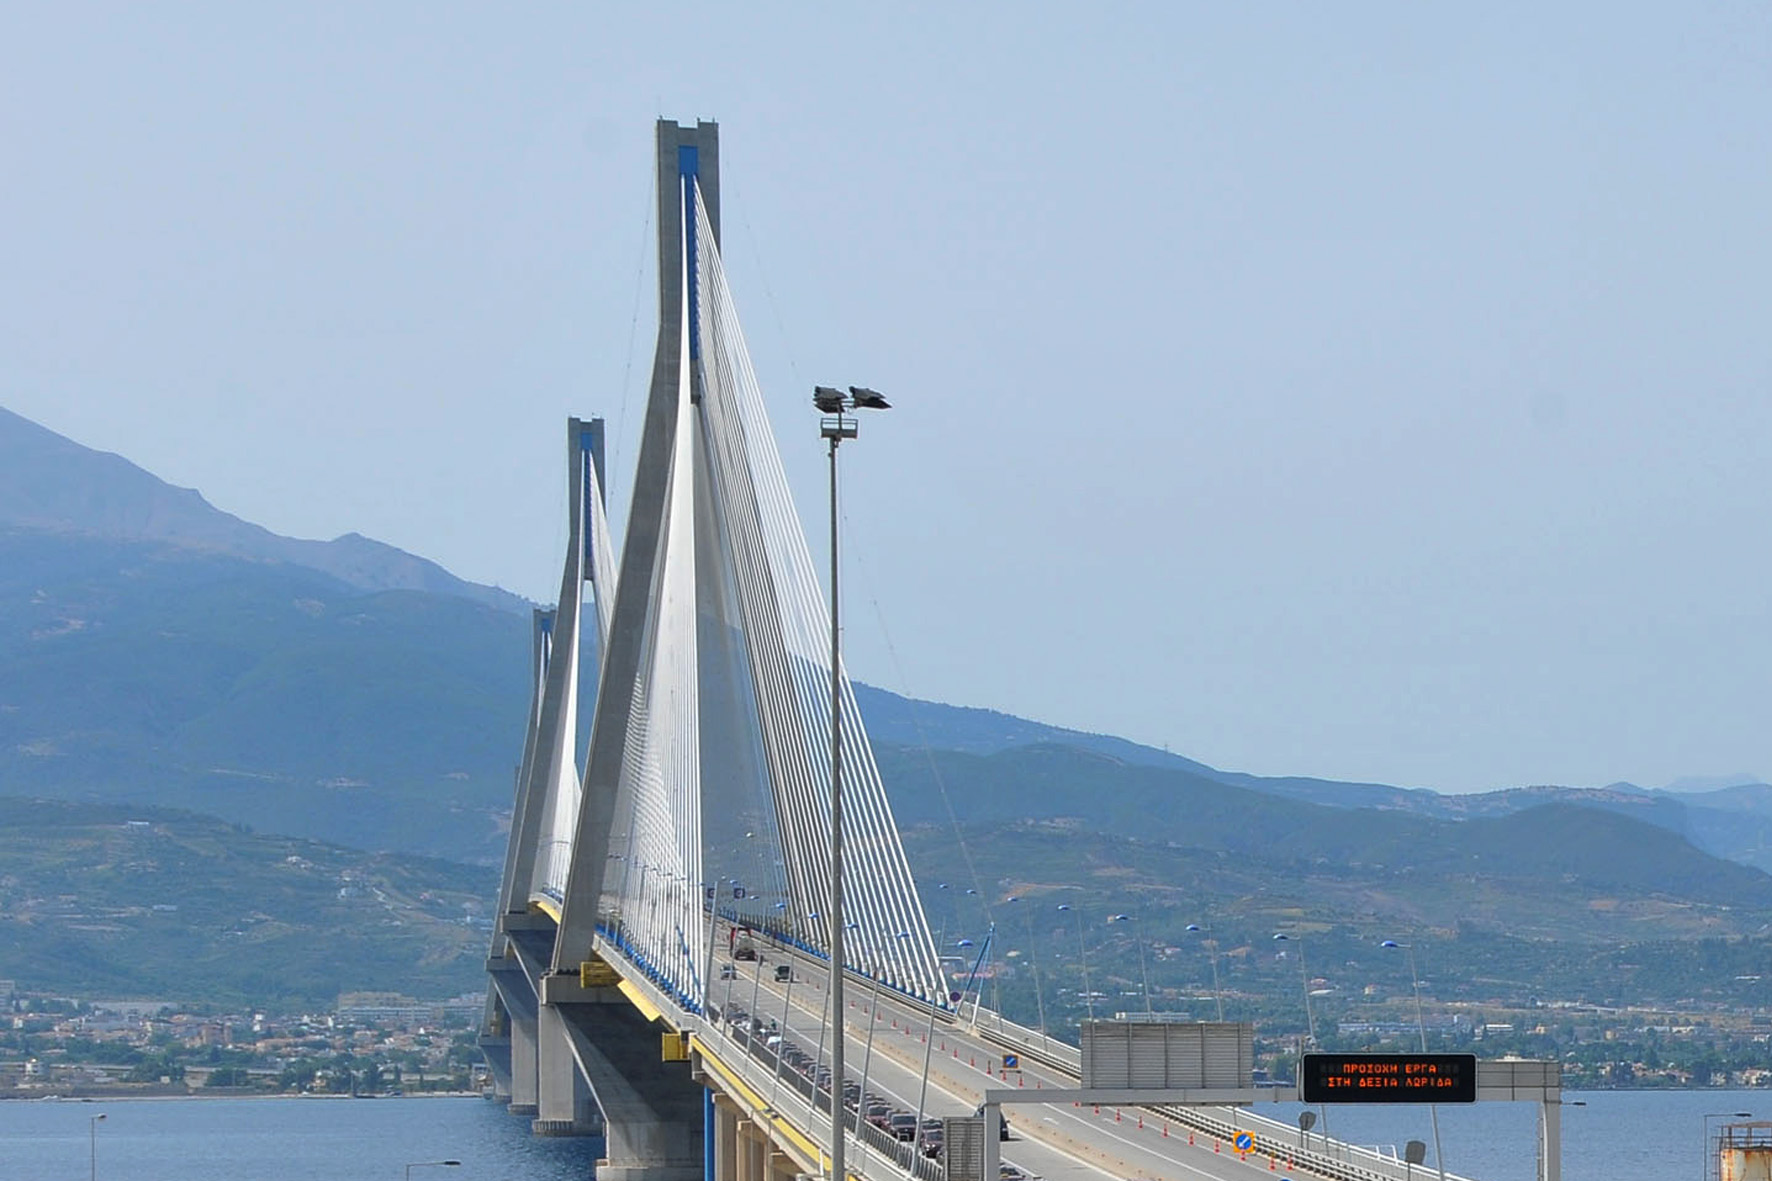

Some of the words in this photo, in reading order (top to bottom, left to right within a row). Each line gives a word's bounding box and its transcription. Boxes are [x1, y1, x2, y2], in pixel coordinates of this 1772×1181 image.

[1343, 1063, 1398, 1074] ΠΡΟΣΟΧΗ
[1405, 1063, 1437, 1074] ΕΡΓΑ
[1327, 1077, 1351, 1087] ΣΤΗ
[1359, 1077, 1398, 1087] ΔΕΞΙΑ
[1405, 1077, 1453, 1087] ΛΩΡΙΔΑ
